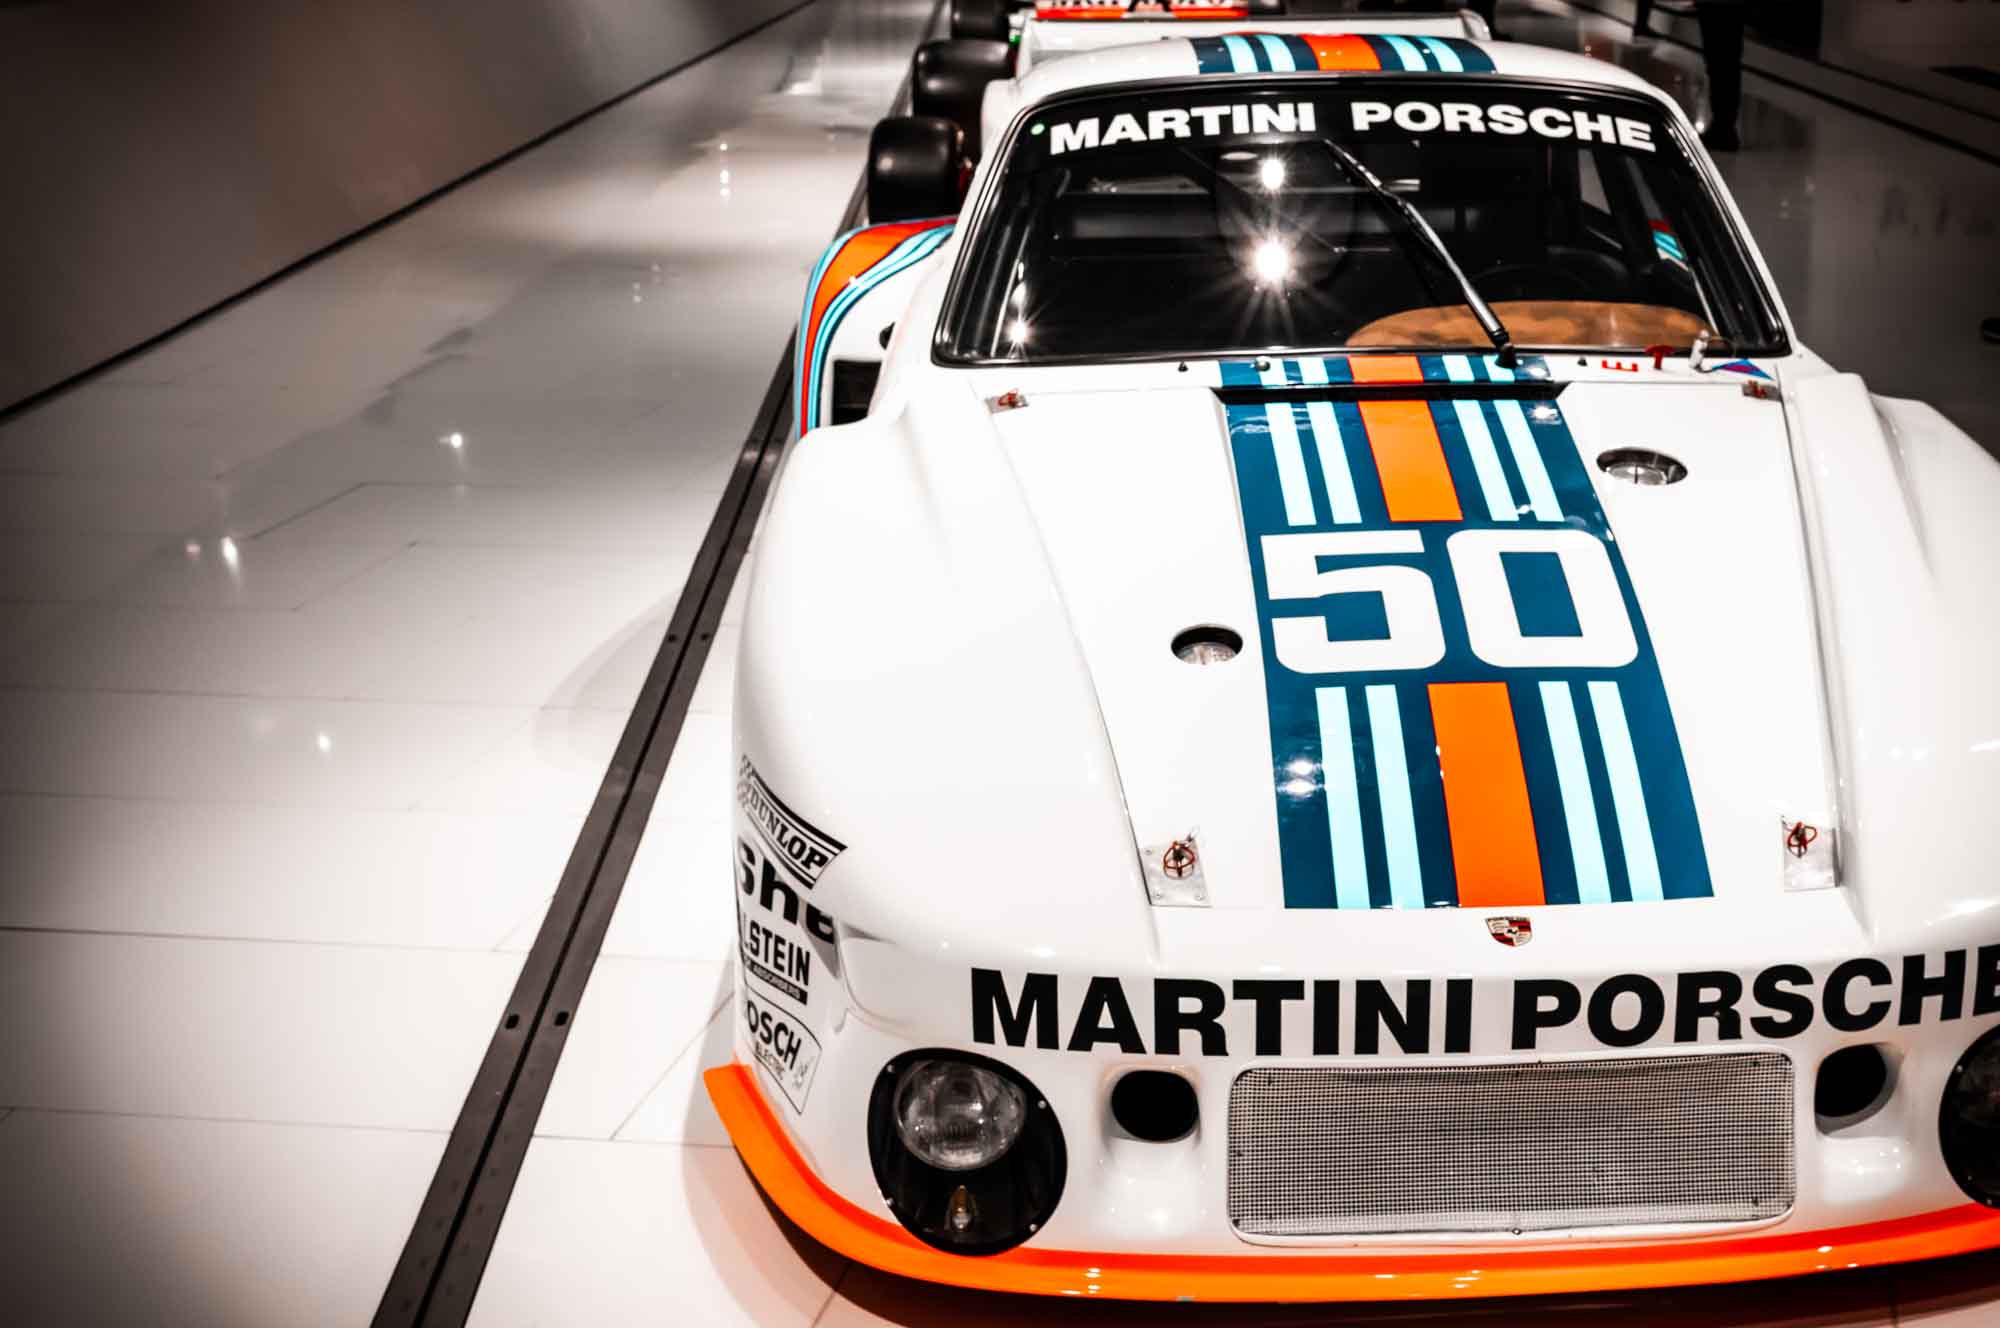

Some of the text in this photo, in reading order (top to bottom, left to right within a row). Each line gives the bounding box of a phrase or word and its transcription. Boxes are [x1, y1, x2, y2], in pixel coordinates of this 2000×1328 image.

[1050, 101, 1656, 155] MARTINI PORSCHE
[1260, 529, 1639, 674] 50
[750, 786, 830, 870] DUNLOP
[971, 967, 1473, 1057] MARTINI
